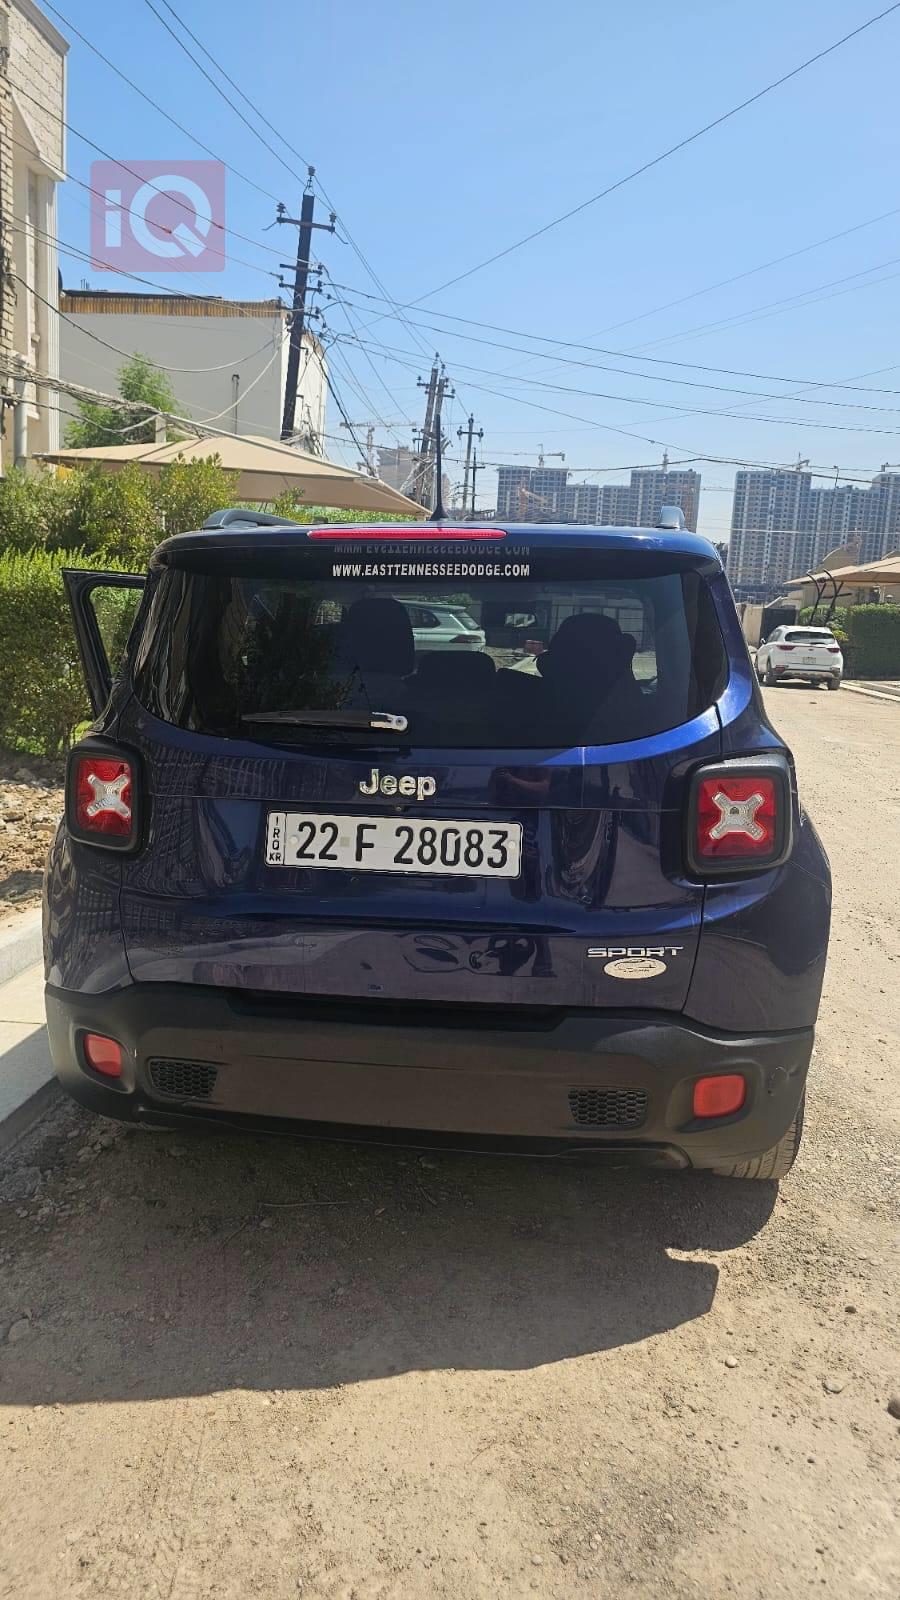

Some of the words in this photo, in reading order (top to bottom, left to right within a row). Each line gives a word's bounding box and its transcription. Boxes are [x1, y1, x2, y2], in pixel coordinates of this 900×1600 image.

[332, 564, 530, 577] WWW.EASTTENNESSEEDODGE.COM
[359, 768, 436, 801] Jeep
[296, 821, 339, 860] 22
[355, 824, 377, 862] F
[393, 826, 508, 868] 28083
[269, 852, 281, 862] KR
[587, 946, 684, 958] SPORT
